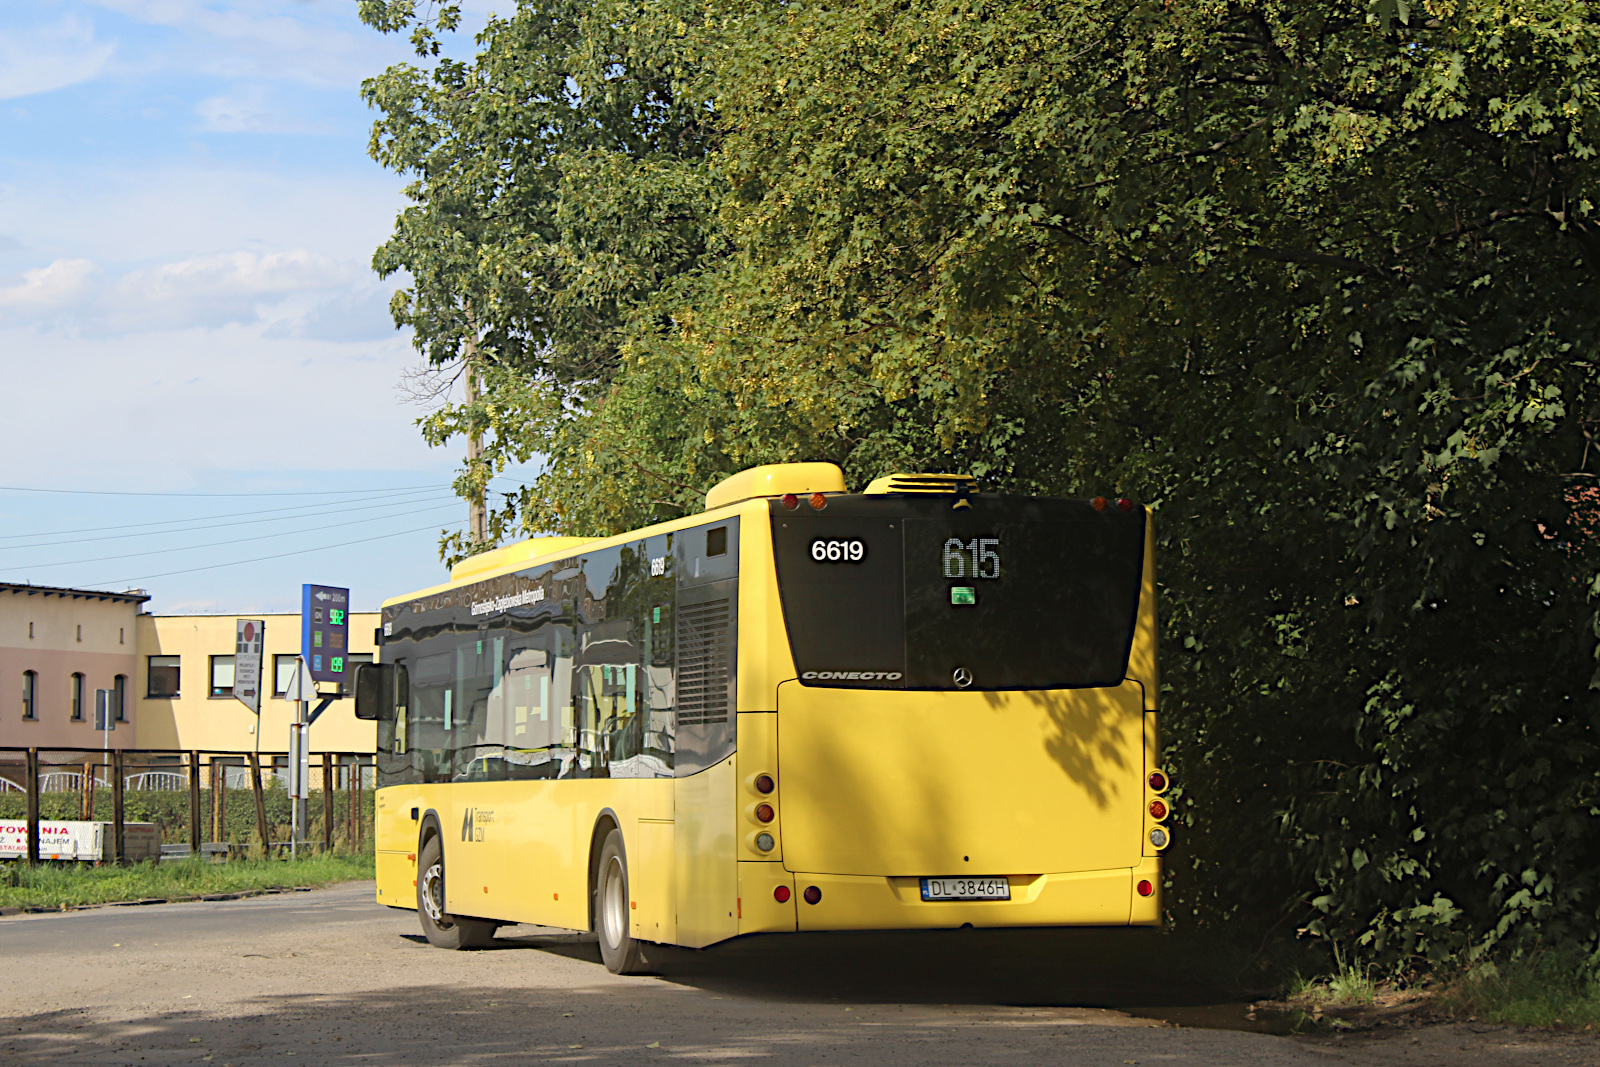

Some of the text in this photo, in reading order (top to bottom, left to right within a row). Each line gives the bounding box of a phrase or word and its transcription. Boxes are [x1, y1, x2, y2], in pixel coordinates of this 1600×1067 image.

[811, 540, 864, 561] 6619
[944, 538, 1000, 578] 615
[651, 557, 665, 577] 6619
[802, 671, 902, 681] CONECTO
[475, 807, 494, 825] Transport
[0, 826, 69, 835] TOWNIA
[957, 880, 1005, 896] 3846H
